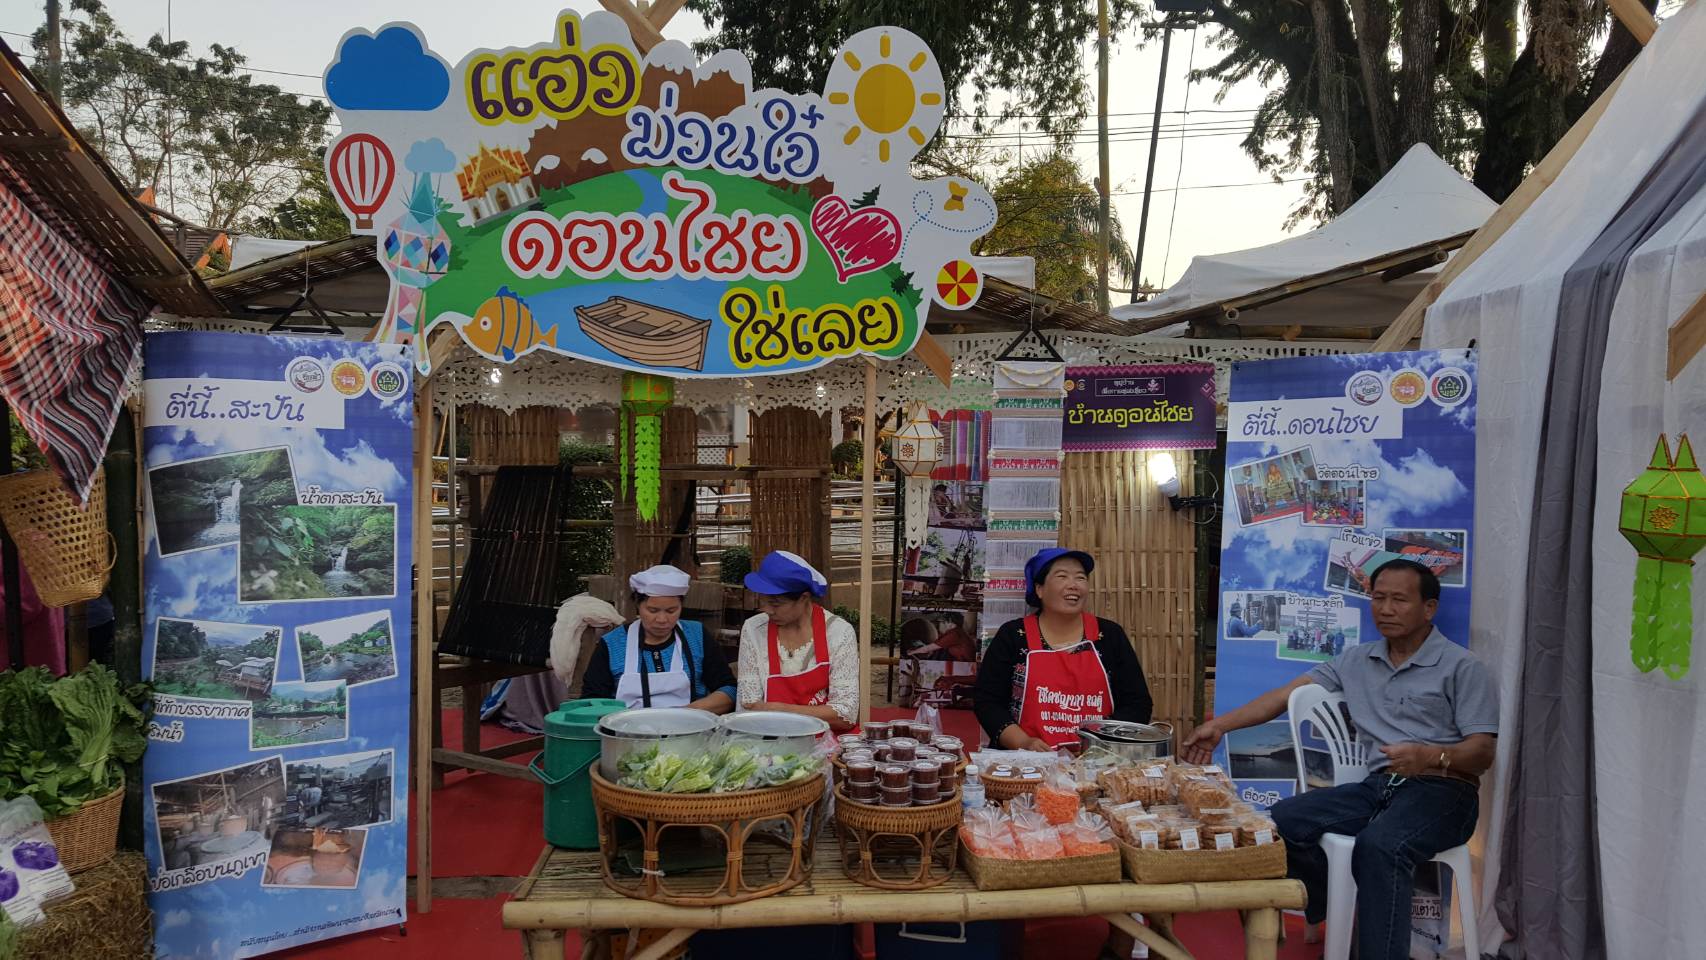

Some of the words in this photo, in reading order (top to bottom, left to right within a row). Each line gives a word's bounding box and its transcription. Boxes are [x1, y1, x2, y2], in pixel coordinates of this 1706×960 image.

[472, 21, 635, 119] แอ่ว
[627, 87, 825, 178] ม่วนใจ๋
[508, 178, 801, 277] ดอนไชย
[725, 291, 899, 364] ใช่เลย
[301, 486, 383, 505] น้ำตกสะปัน
[151, 851, 267, 891] บ่อเกลือบนภูเขา
